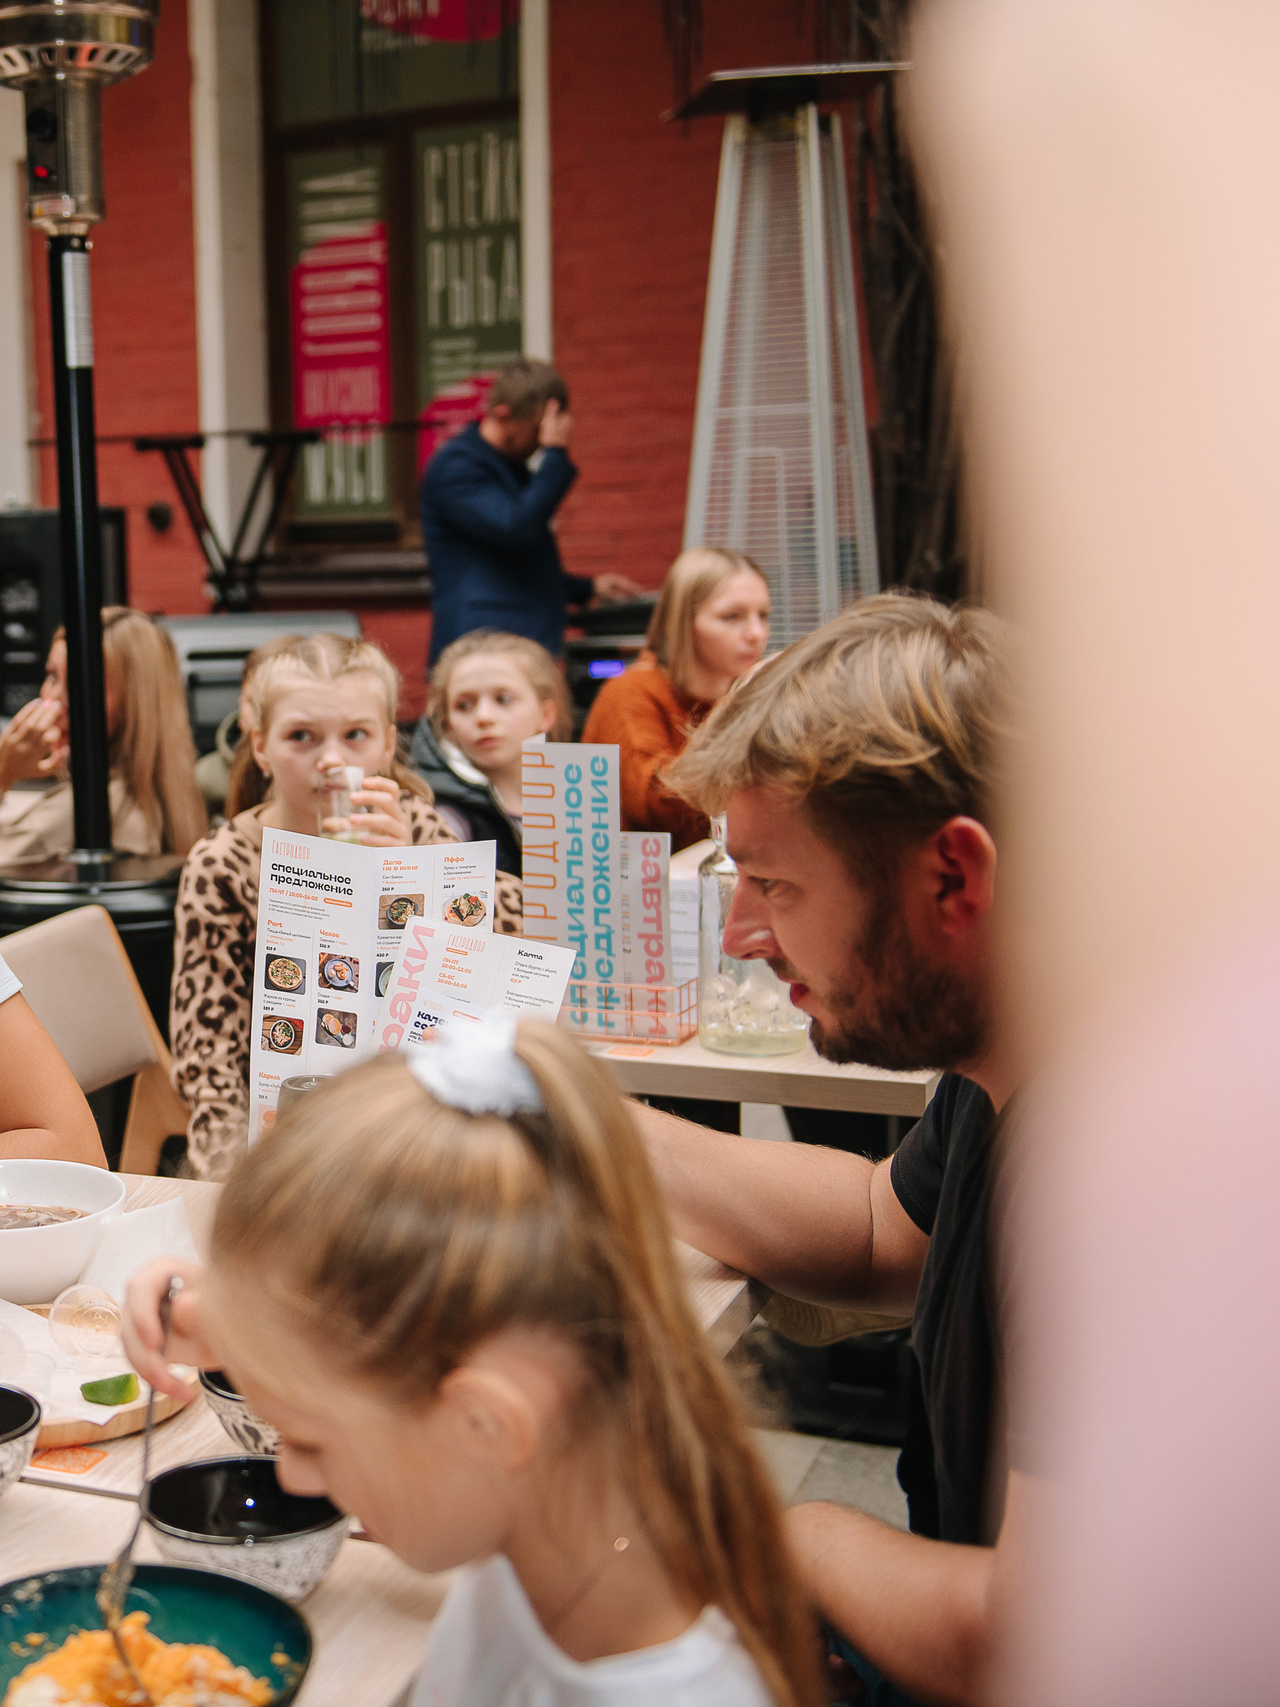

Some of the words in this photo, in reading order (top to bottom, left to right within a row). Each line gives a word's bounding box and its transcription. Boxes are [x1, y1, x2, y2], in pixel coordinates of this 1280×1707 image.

[270, 873, 354, 896] предложение
[271, 862, 352, 885] специальное
[564, 763, 589, 1026] специальное
[590, 755, 620, 1029] предложение
[517, 949, 544, 960] Karma
[637, 837, 668, 1036] завтраки
